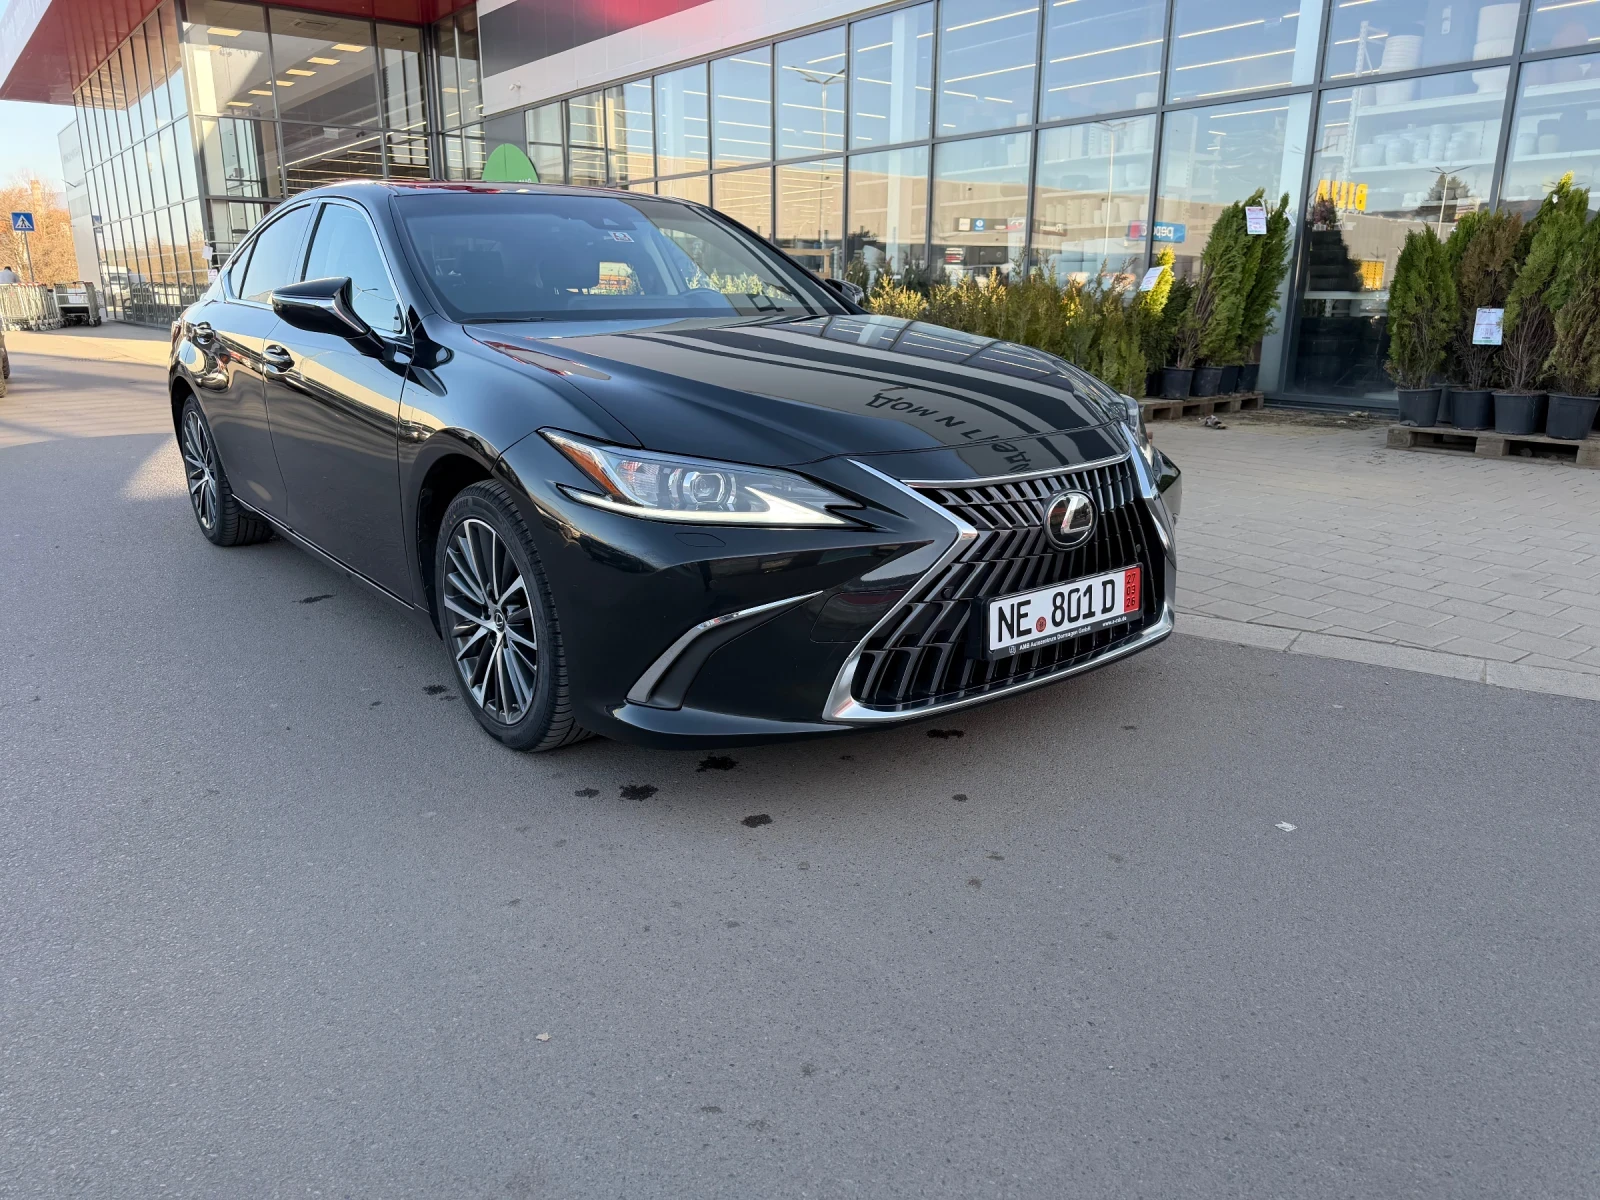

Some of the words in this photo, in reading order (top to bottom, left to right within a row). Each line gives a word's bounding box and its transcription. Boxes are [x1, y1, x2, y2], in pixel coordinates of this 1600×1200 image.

[1126, 573, 1136, 584] 27
[1126, 586, 1136, 597] 03
[1126, 598, 1136, 608] 26
[998, 600, 1032, 643] NE
[1052, 584, 1095, 627] 801
[1101, 579, 1115, 614] D
